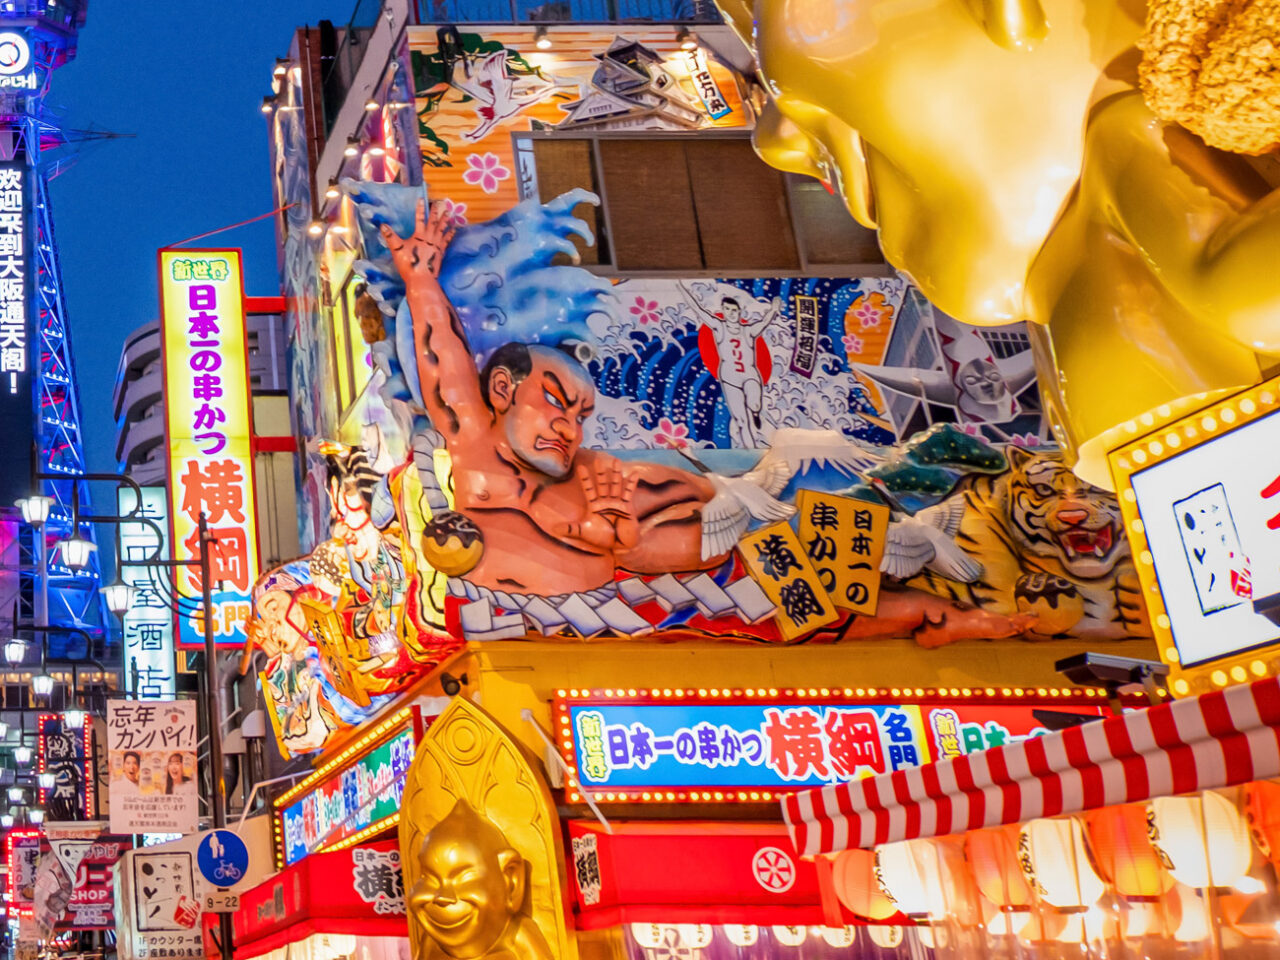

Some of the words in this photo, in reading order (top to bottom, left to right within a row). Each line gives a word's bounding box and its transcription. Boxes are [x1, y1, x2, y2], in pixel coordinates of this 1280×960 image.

[172, 260, 230, 281] 新世界
[188, 285, 227, 454] 日本一の串かつ
[181, 459, 249, 594] 横綱
[808, 502, 839, 593] 串かつ
[846, 509, 873, 605] 日本一の
[754, 534, 825, 628] 横綱
[189, 604, 252, 635] 名門
[110, 705, 157, 728] 忘年
[581, 714, 608, 778] 新世界
[607, 726, 762, 766] 日本一の串かつ
[766, 710, 885, 776] 横綱
[883, 713, 920, 772] 名門
[355, 852, 401, 863] 日本一の
[70, 890, 108, 901] SHOP
[207, 897, 238, 909] 9-22
